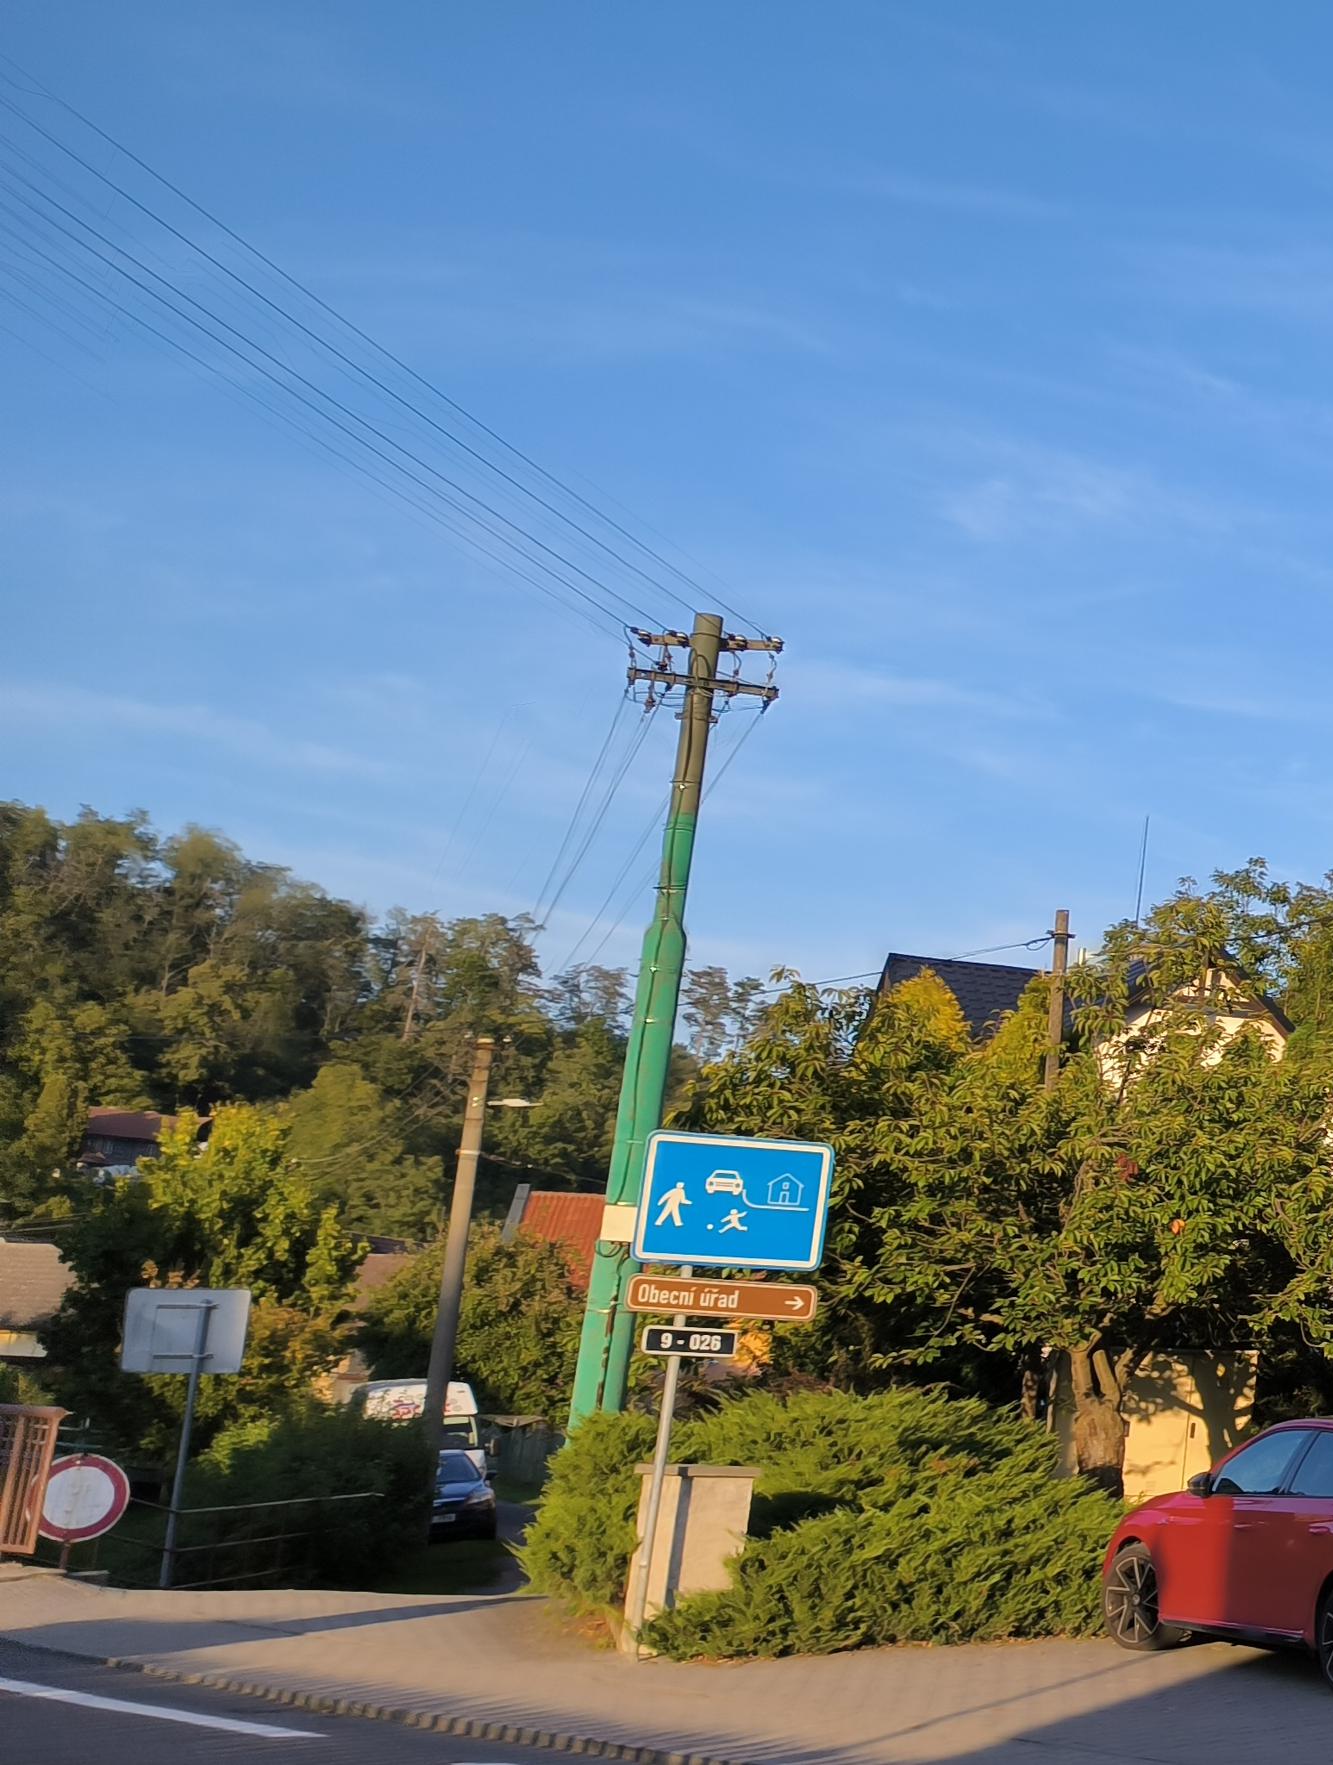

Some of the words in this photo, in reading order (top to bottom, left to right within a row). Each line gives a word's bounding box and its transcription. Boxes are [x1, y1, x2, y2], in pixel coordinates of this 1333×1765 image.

[638, 1284, 695, 1305] Obecní
[700, 1287, 739, 1308] úřad
[660, 1333, 672, 1349] 9
[689, 1334, 721, 1351] 026
